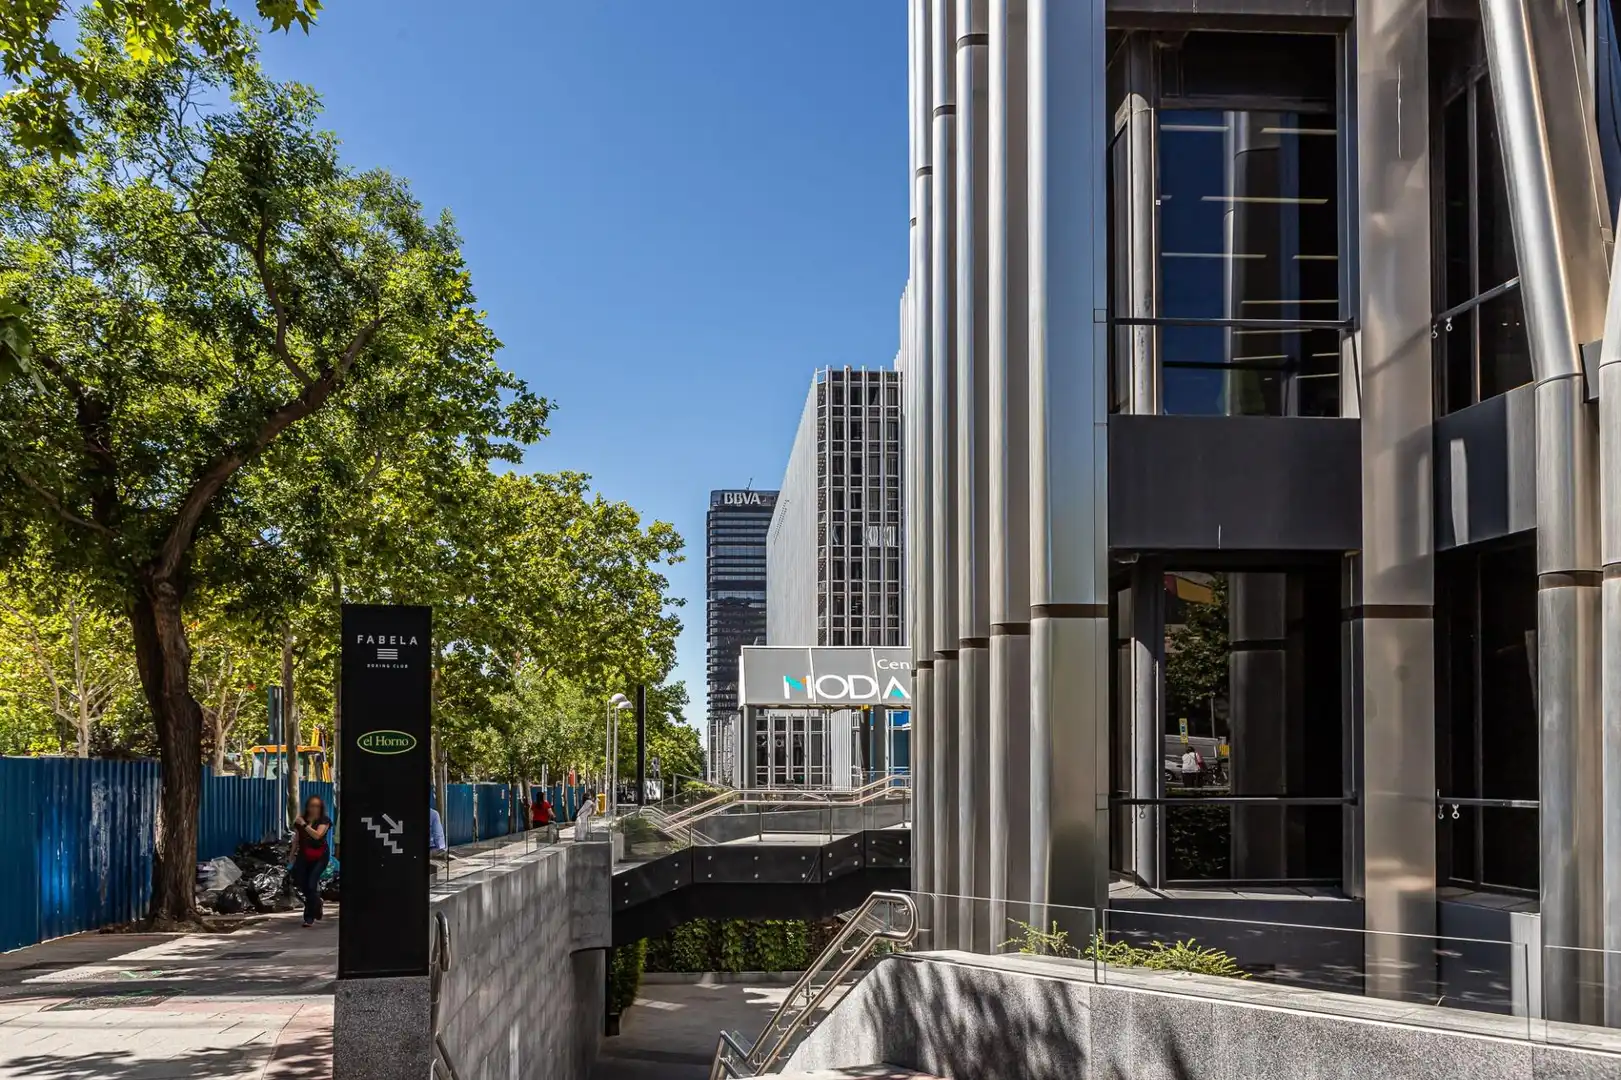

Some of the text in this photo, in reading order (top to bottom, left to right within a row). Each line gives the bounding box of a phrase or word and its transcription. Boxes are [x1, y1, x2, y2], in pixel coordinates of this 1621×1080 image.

[724, 492, 761, 505] BBVA
[357, 634, 418, 645] FABELA
[877, 659, 911, 670] Cen
[783, 674, 911, 700] MODA
[363, 735, 409, 746] el Horno
